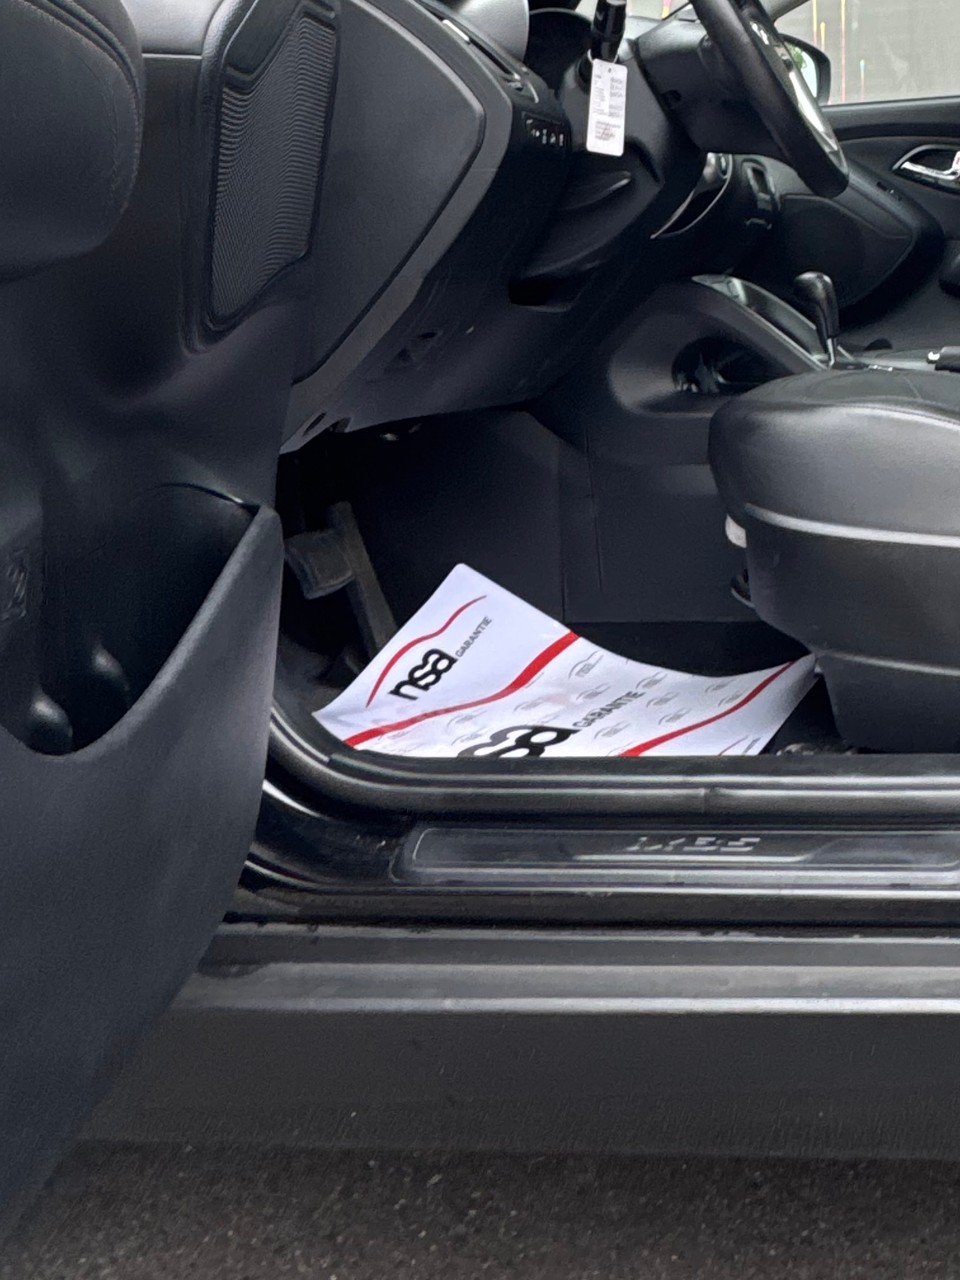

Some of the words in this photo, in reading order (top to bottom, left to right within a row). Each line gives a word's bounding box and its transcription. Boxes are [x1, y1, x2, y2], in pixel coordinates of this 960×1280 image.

[388, 648, 458, 700] nsa
[455, 616, 492, 657] GARANTIE
[572, 691, 646, 727] GARANTIE
